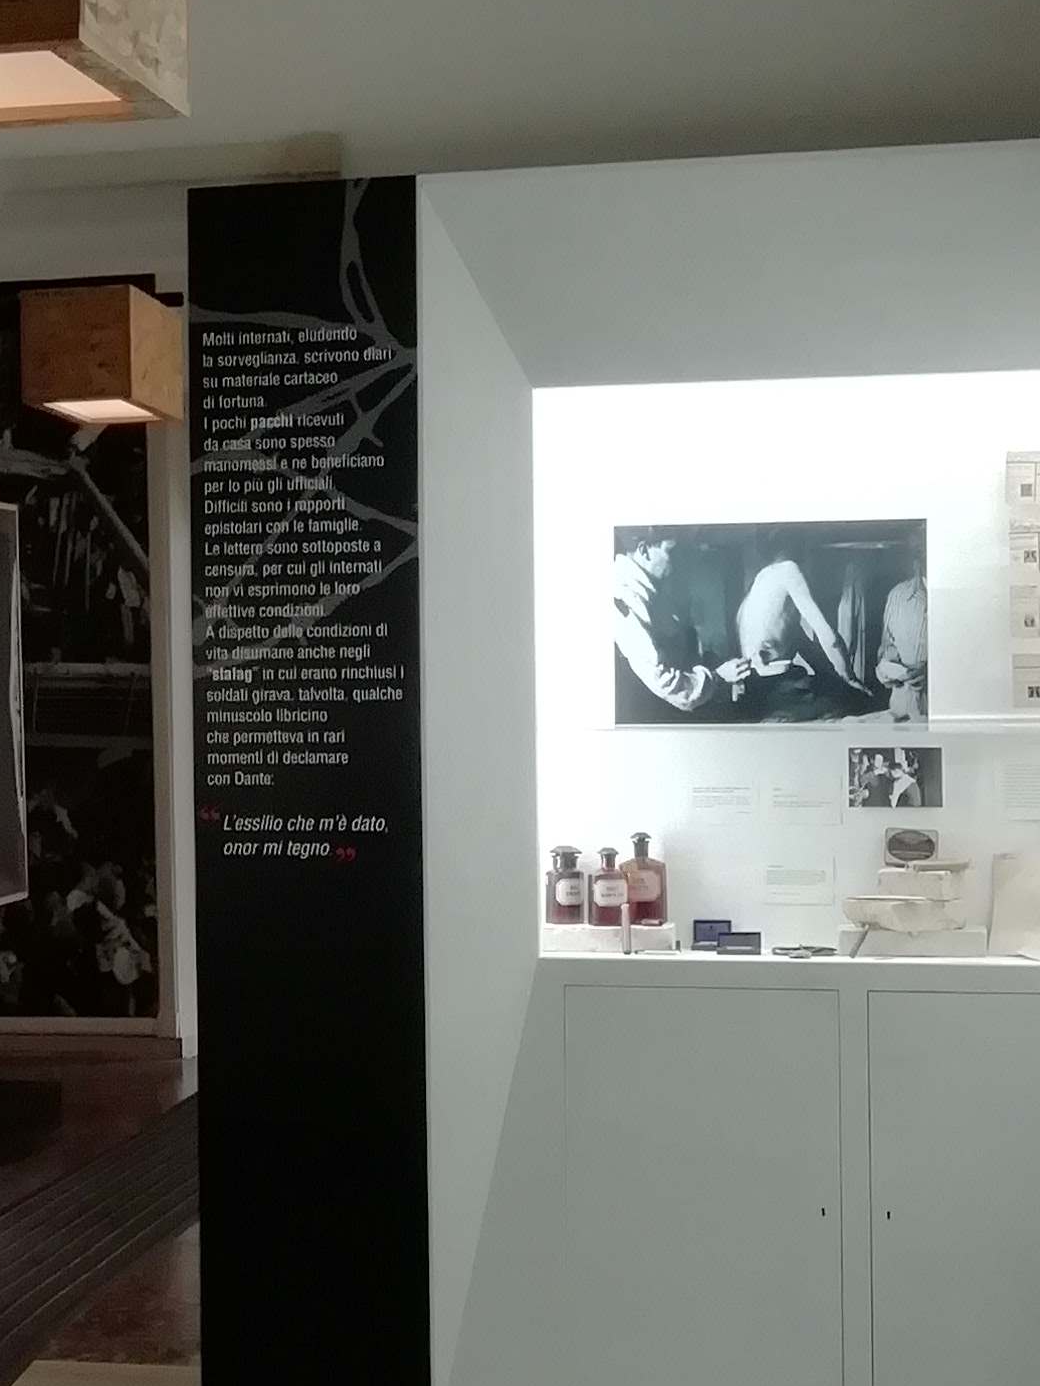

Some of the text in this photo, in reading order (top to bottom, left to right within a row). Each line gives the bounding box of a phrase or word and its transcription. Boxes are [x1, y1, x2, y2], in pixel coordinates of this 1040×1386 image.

[203, 327, 357, 346] Molti internati, eludendo
[203, 353, 213, 367] la
[304, 349, 359, 363] scrivono
[363, 346, 392, 361] diari
[203, 372, 338, 388] su materiale cartaceo
[203, 395, 214, 409] di
[204, 412, 344, 433] I pochi pacchi ricevuti
[204, 436, 335, 451] da casa sono spesso
[280, 458, 288, 469] e
[292, 458, 307, 469] ne
[311, 452, 384, 469] beneficiano
[204, 481, 223, 495] per
[228, 479, 240, 492] lo
[244, 478, 263, 494] più
[267, 477, 283, 494] gli
[205, 496, 345, 514] Difficili sono i rapporti
[205, 517, 362, 537] epistolari con le famiglie.
[205, 539, 381, 555] Le lettere sono sottoposte a
[262, 563, 282, 577] per
[287, 562, 305, 575] cui
[310, 560, 325, 577] gli
[330, 559, 382, 574] internati
[205, 581, 360, 599] non vi esprimono le loro
[205, 626, 214, 639] A
[218, 625, 269, 640] dispetto
[307, 623, 371, 637] condizioni
[376, 623, 387, 637] di
[206, 644, 370, 661] vita disumane anche negli
[262, 666, 274, 680] in
[278, 666, 297, 680] cui
[301, 668, 337, 679] erano
[341, 665, 396, 680] rinchiusi
[400, 665, 404, 679] i
[206, 688, 248, 702] soldati
[352, 687, 403, 703] qualche
[206, 708, 328, 723] minuscolo libricino
[206, 729, 345, 746] che permetteva in rari
[207, 750, 348, 765] momenti di declamare
[207, 771, 274, 786] con Dante:
[287, 814, 314, 831] che
[319, 813, 347, 831] m'è
[351, 814, 388, 833] dato,
[223, 842, 259, 856] onor
[263, 840, 283, 856] mi
